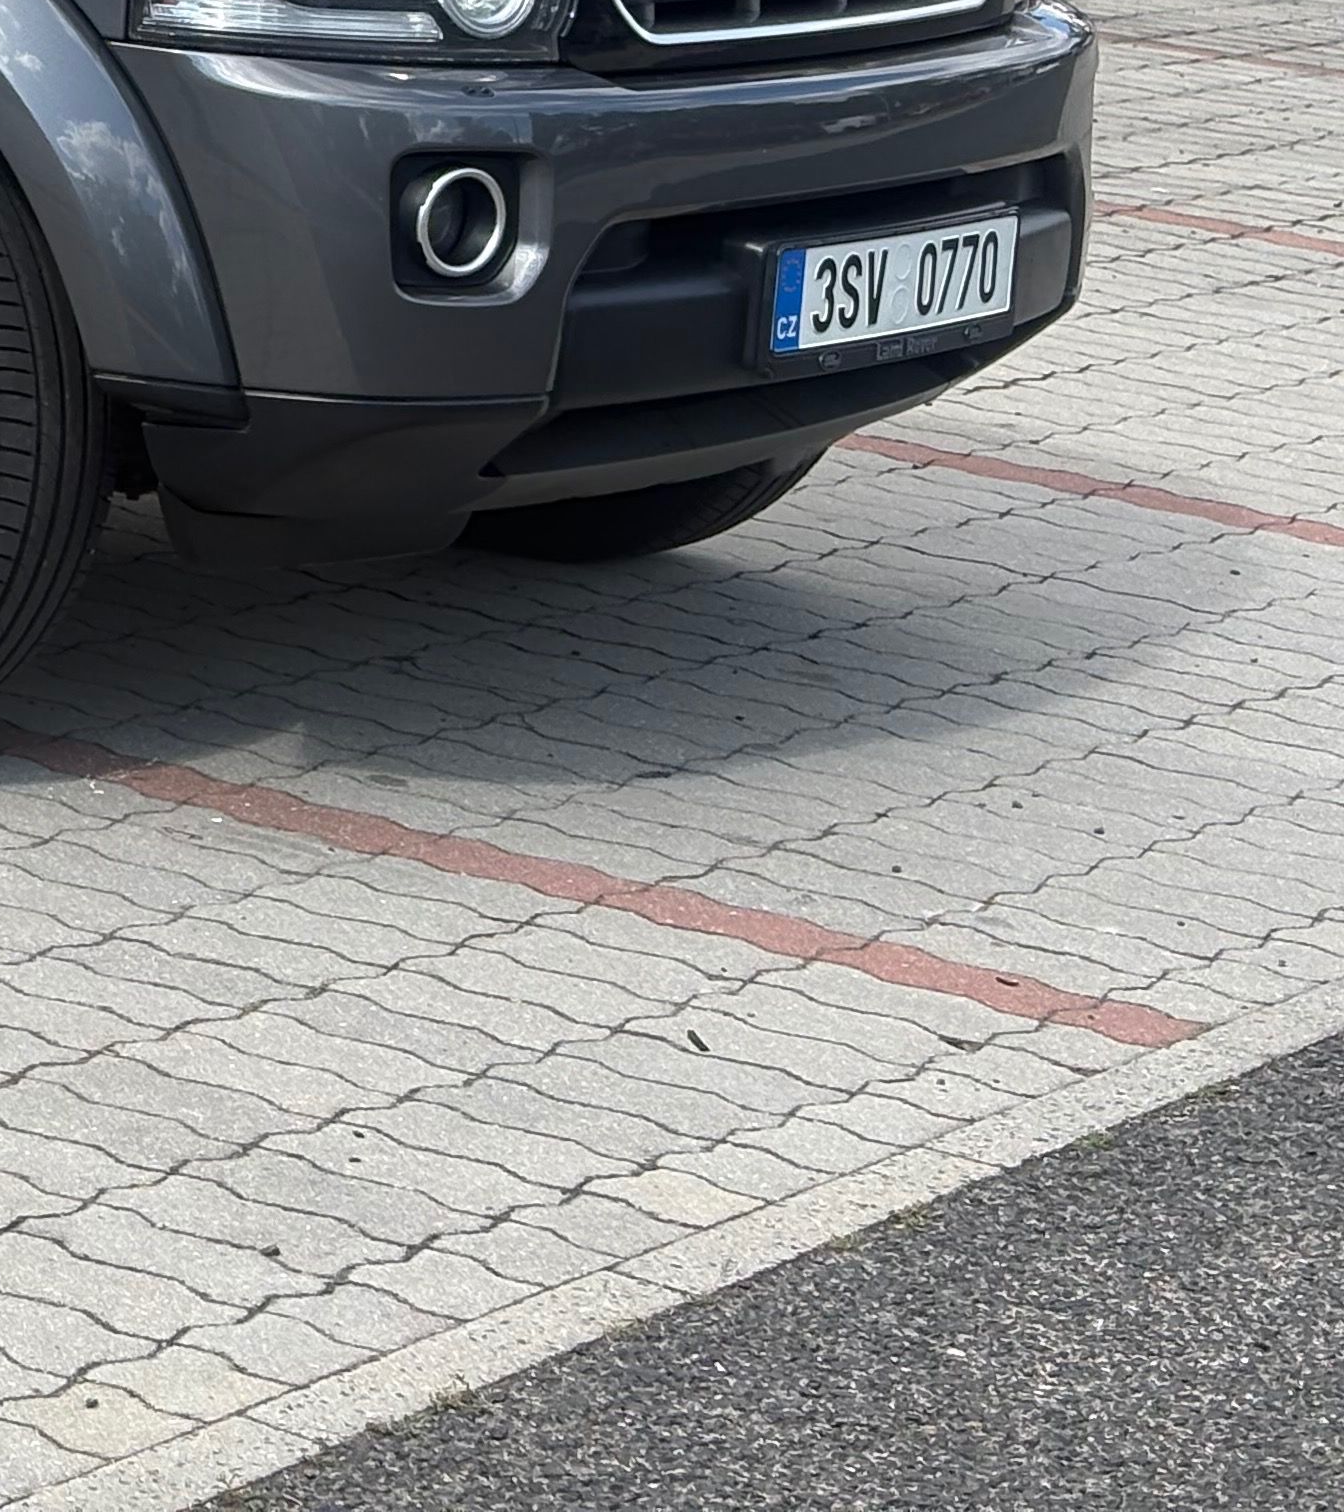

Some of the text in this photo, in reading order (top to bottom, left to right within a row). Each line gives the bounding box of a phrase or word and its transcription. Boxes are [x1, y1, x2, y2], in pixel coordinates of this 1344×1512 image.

[812, 228, 999, 334] 3SV 0770
[777, 315, 799, 340] CZ
